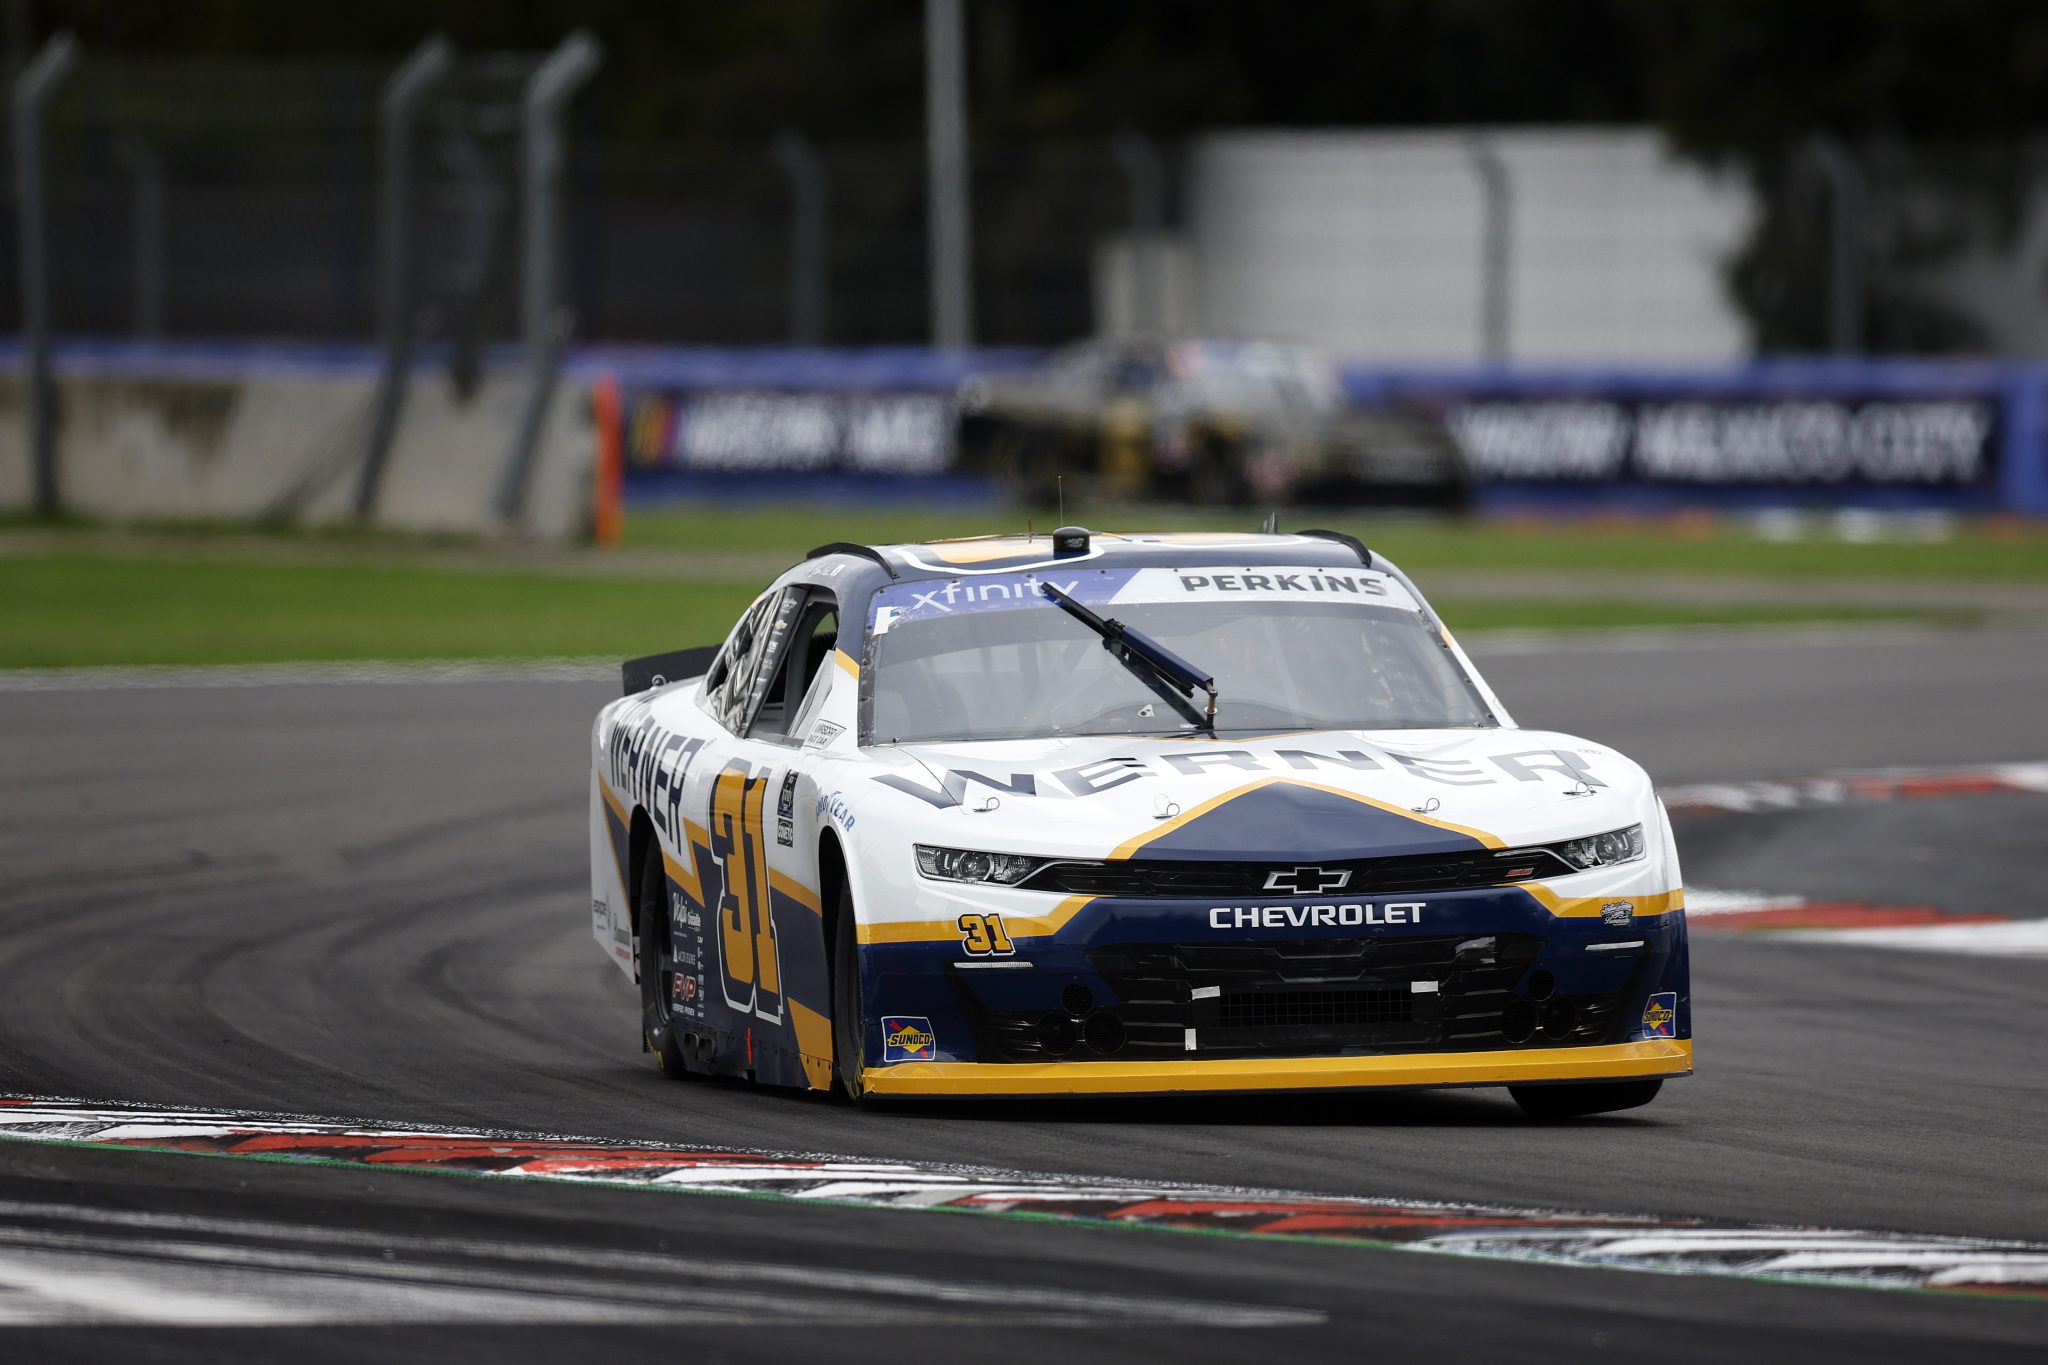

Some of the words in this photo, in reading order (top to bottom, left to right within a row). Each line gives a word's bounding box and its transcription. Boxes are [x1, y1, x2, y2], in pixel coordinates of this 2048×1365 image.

[911, 577, 1079, 612] xfinity
[1179, 574, 1388, 596] PERKINS
[870, 750, 1608, 808] WERNER
[708, 758, 783, 1025] 31
[1209, 903, 1427, 928] CHEVROLET
[957, 913, 1015, 956] 31
[889, 1032, 932, 1047] SUNOCO
